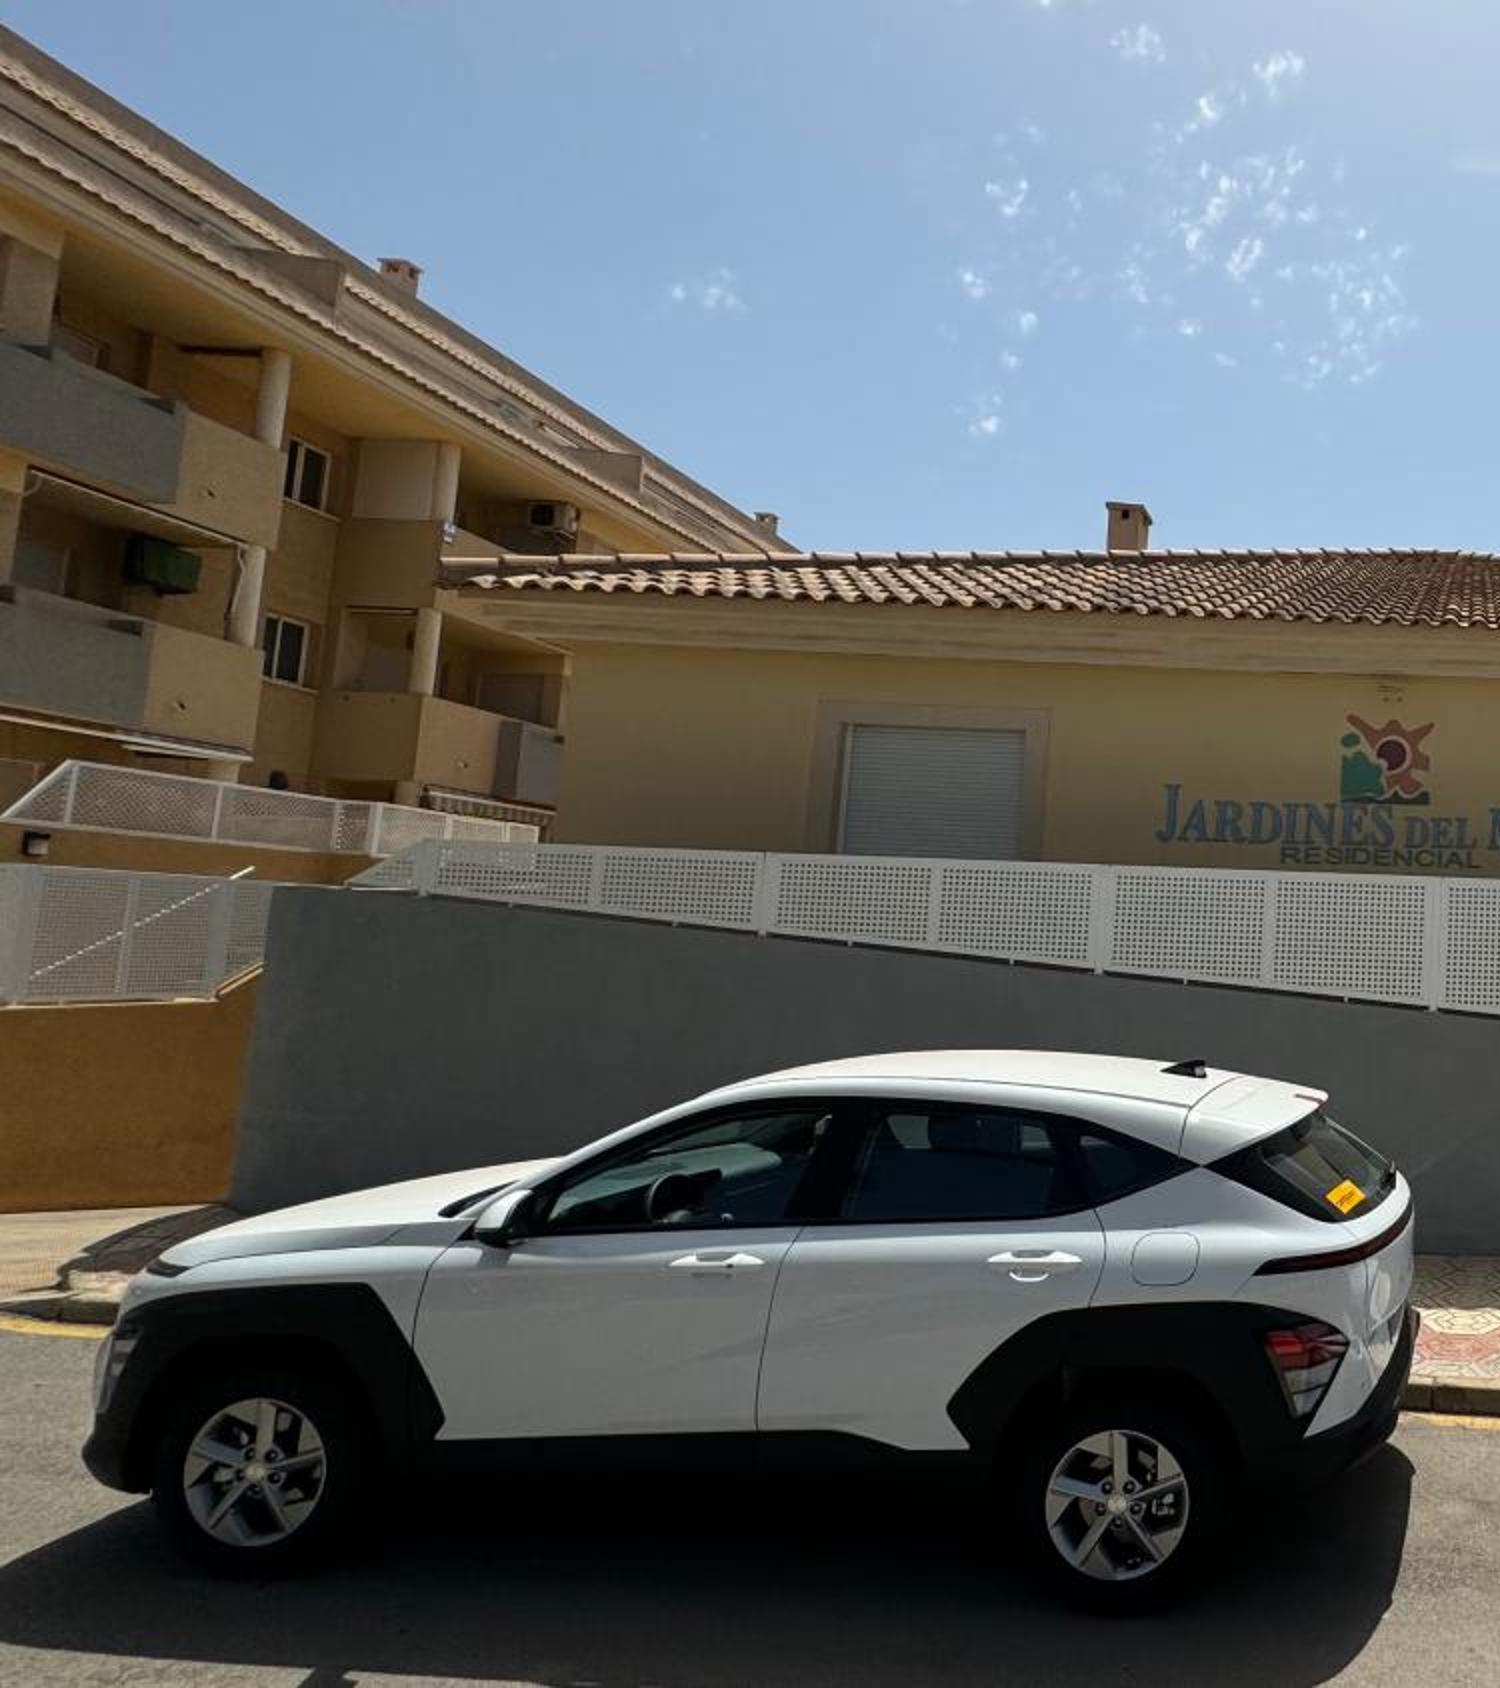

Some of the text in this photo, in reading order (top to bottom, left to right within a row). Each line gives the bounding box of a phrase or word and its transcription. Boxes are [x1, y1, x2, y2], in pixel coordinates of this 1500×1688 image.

[1154, 783, 1395, 849] JARDINES
[1404, 816, 1478, 850] DEL
[1279, 846, 1484, 869] RESIDENCIAL
